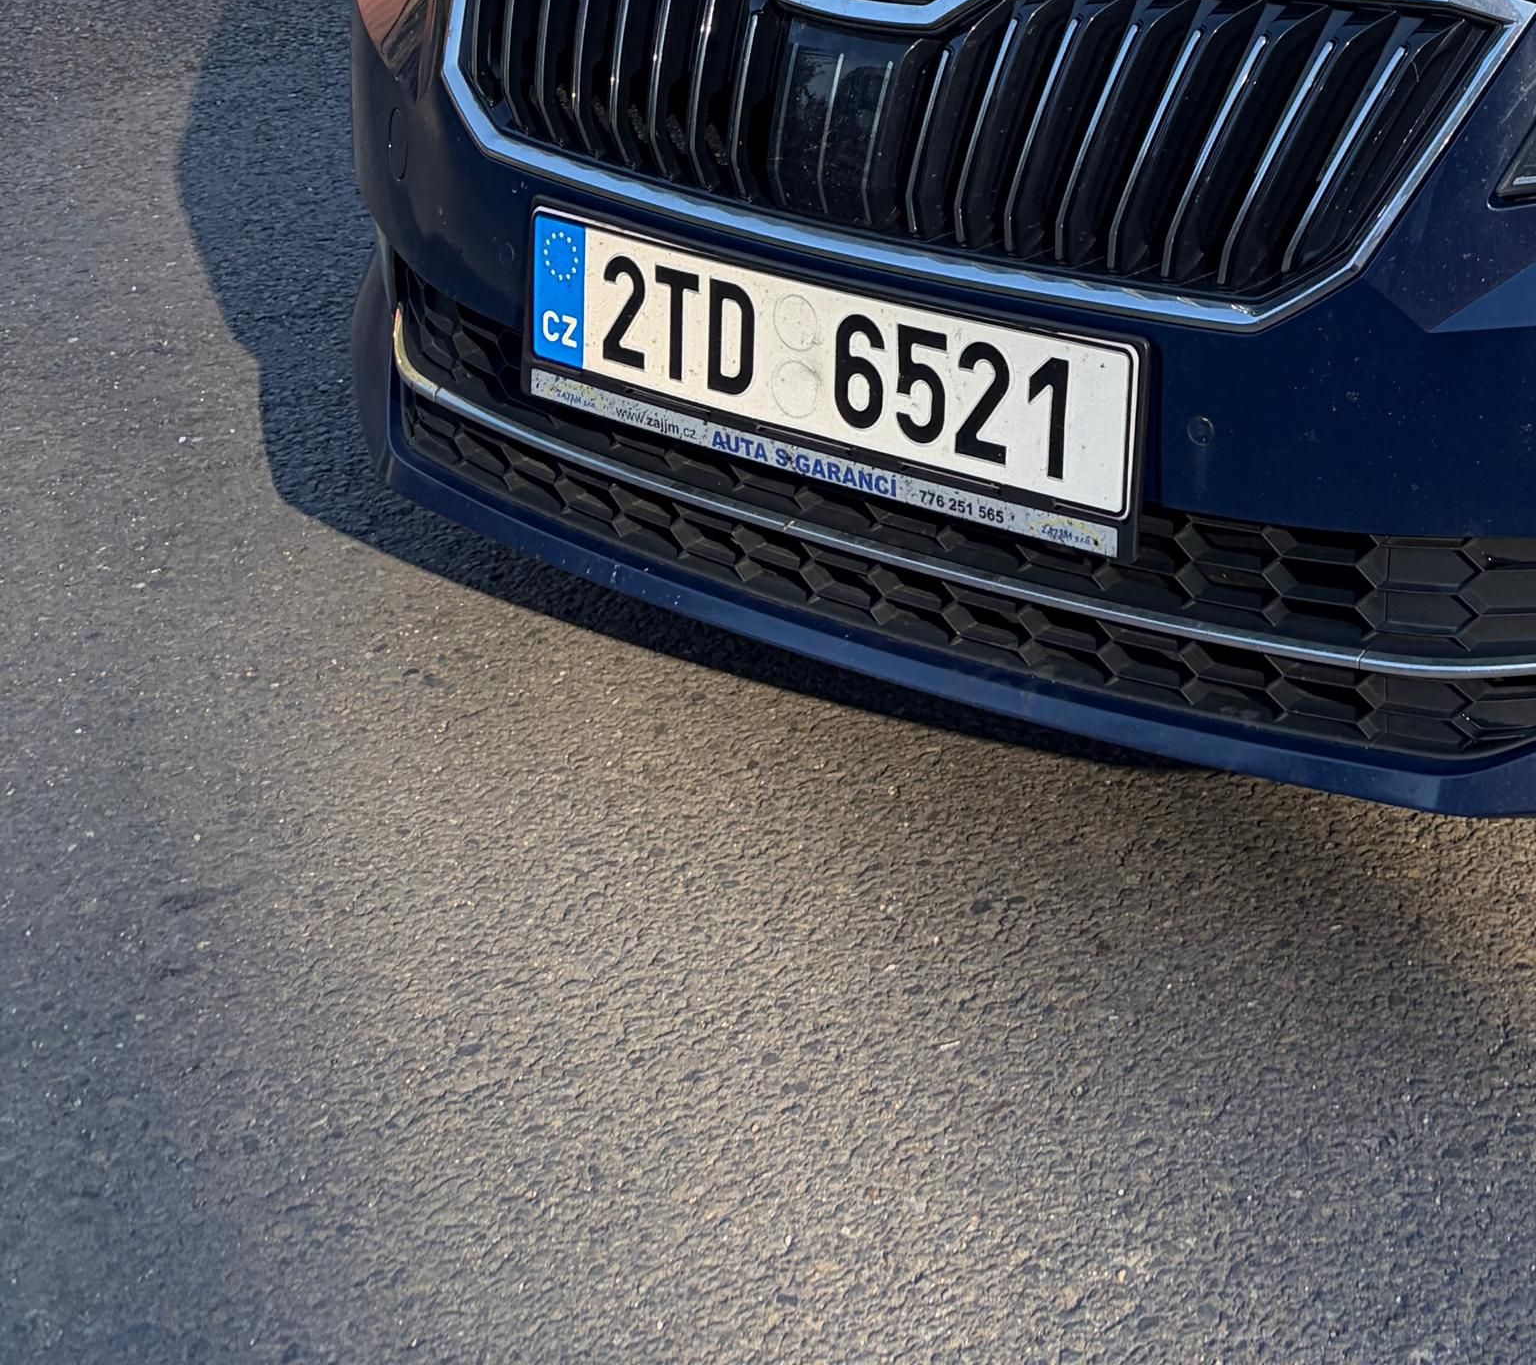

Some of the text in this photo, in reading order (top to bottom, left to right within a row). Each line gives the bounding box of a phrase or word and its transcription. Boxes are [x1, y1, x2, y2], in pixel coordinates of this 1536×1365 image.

[540, 256, 1067, 481] CZ 2TD 6521
[615, 406, 1005, 524] www.zajjm.cz AUTA S GARANCÍ 776 251 565
